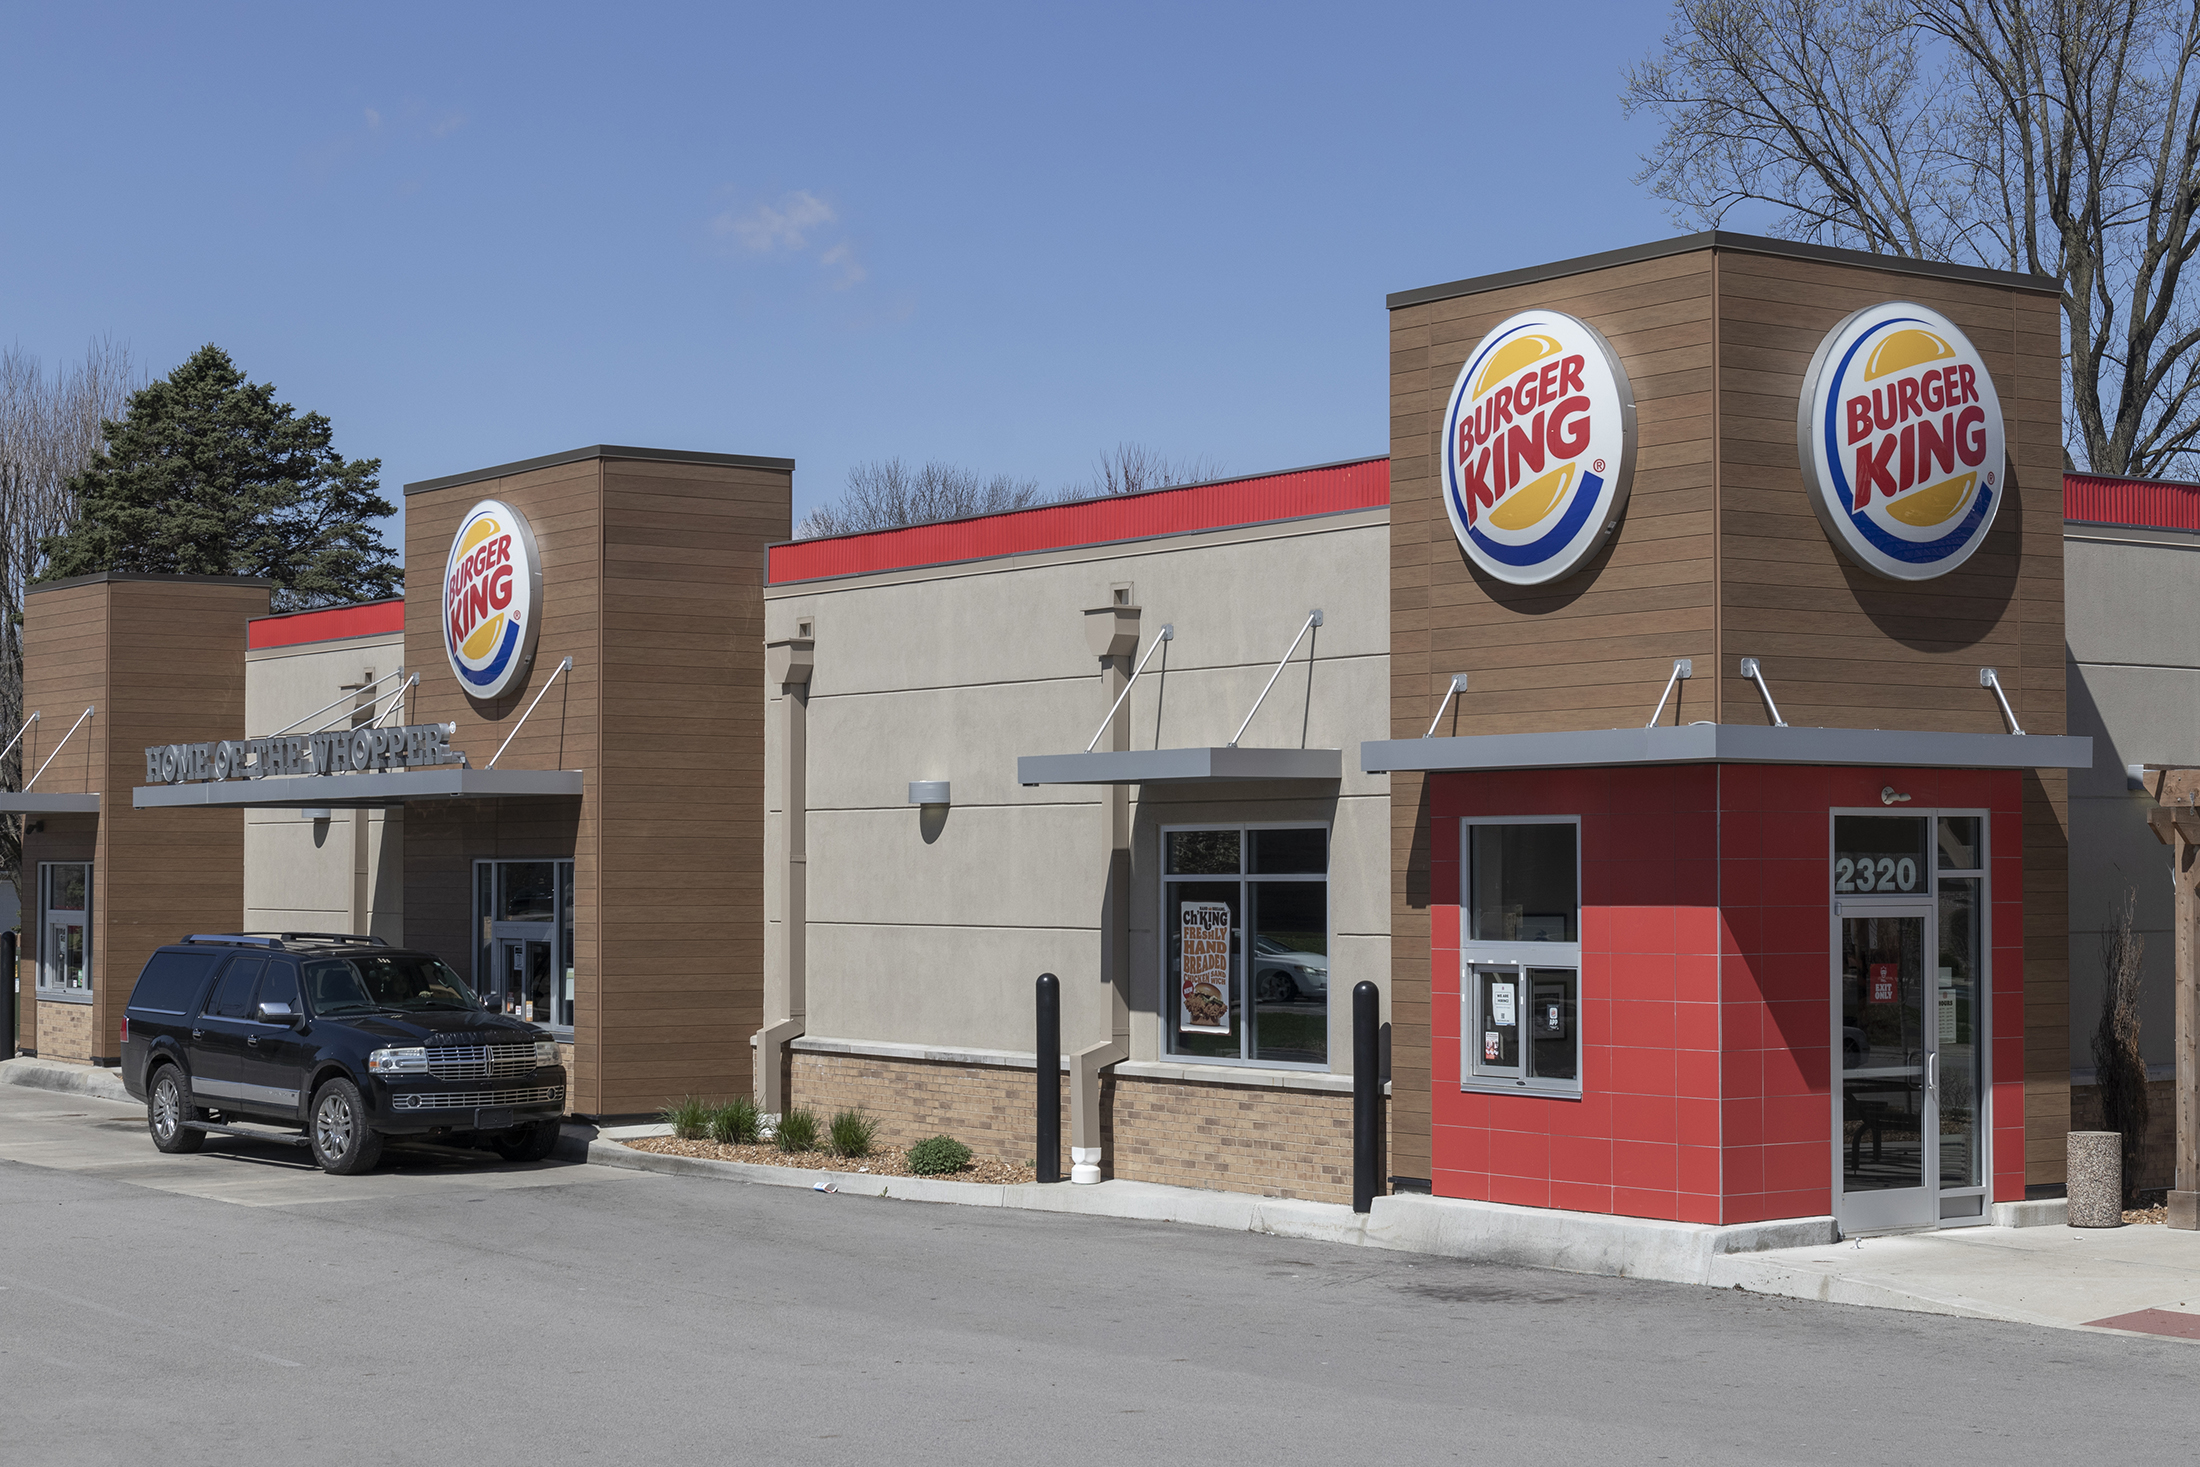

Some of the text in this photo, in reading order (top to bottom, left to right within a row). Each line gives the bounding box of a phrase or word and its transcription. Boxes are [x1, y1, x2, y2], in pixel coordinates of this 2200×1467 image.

[1459, 354, 1585, 467] BURGER
[1846, 364, 1979, 446] BURGER
[1465, 395, 1591, 528] KING
[1852, 405, 1987, 512] KING
[450, 534, 511, 609] BURGER
[451, 564, 513, 655] KING
[146, 723, 444, 782] HOME OF THE WHOPPER
[1835, 857, 1917, 892] 2320
[1184, 927, 1227, 941] FRESHLY
[1184, 940, 1227, 955] HAND
[1184, 954, 1227, 975] BREADED
[1184, 970, 1226, 984] CHICKEN SAND
[1211, 977, 1226, 985] WICH
[1875, 983, 1892, 992] EXIT
[1875, 991, 1893, 1000] ONLY
